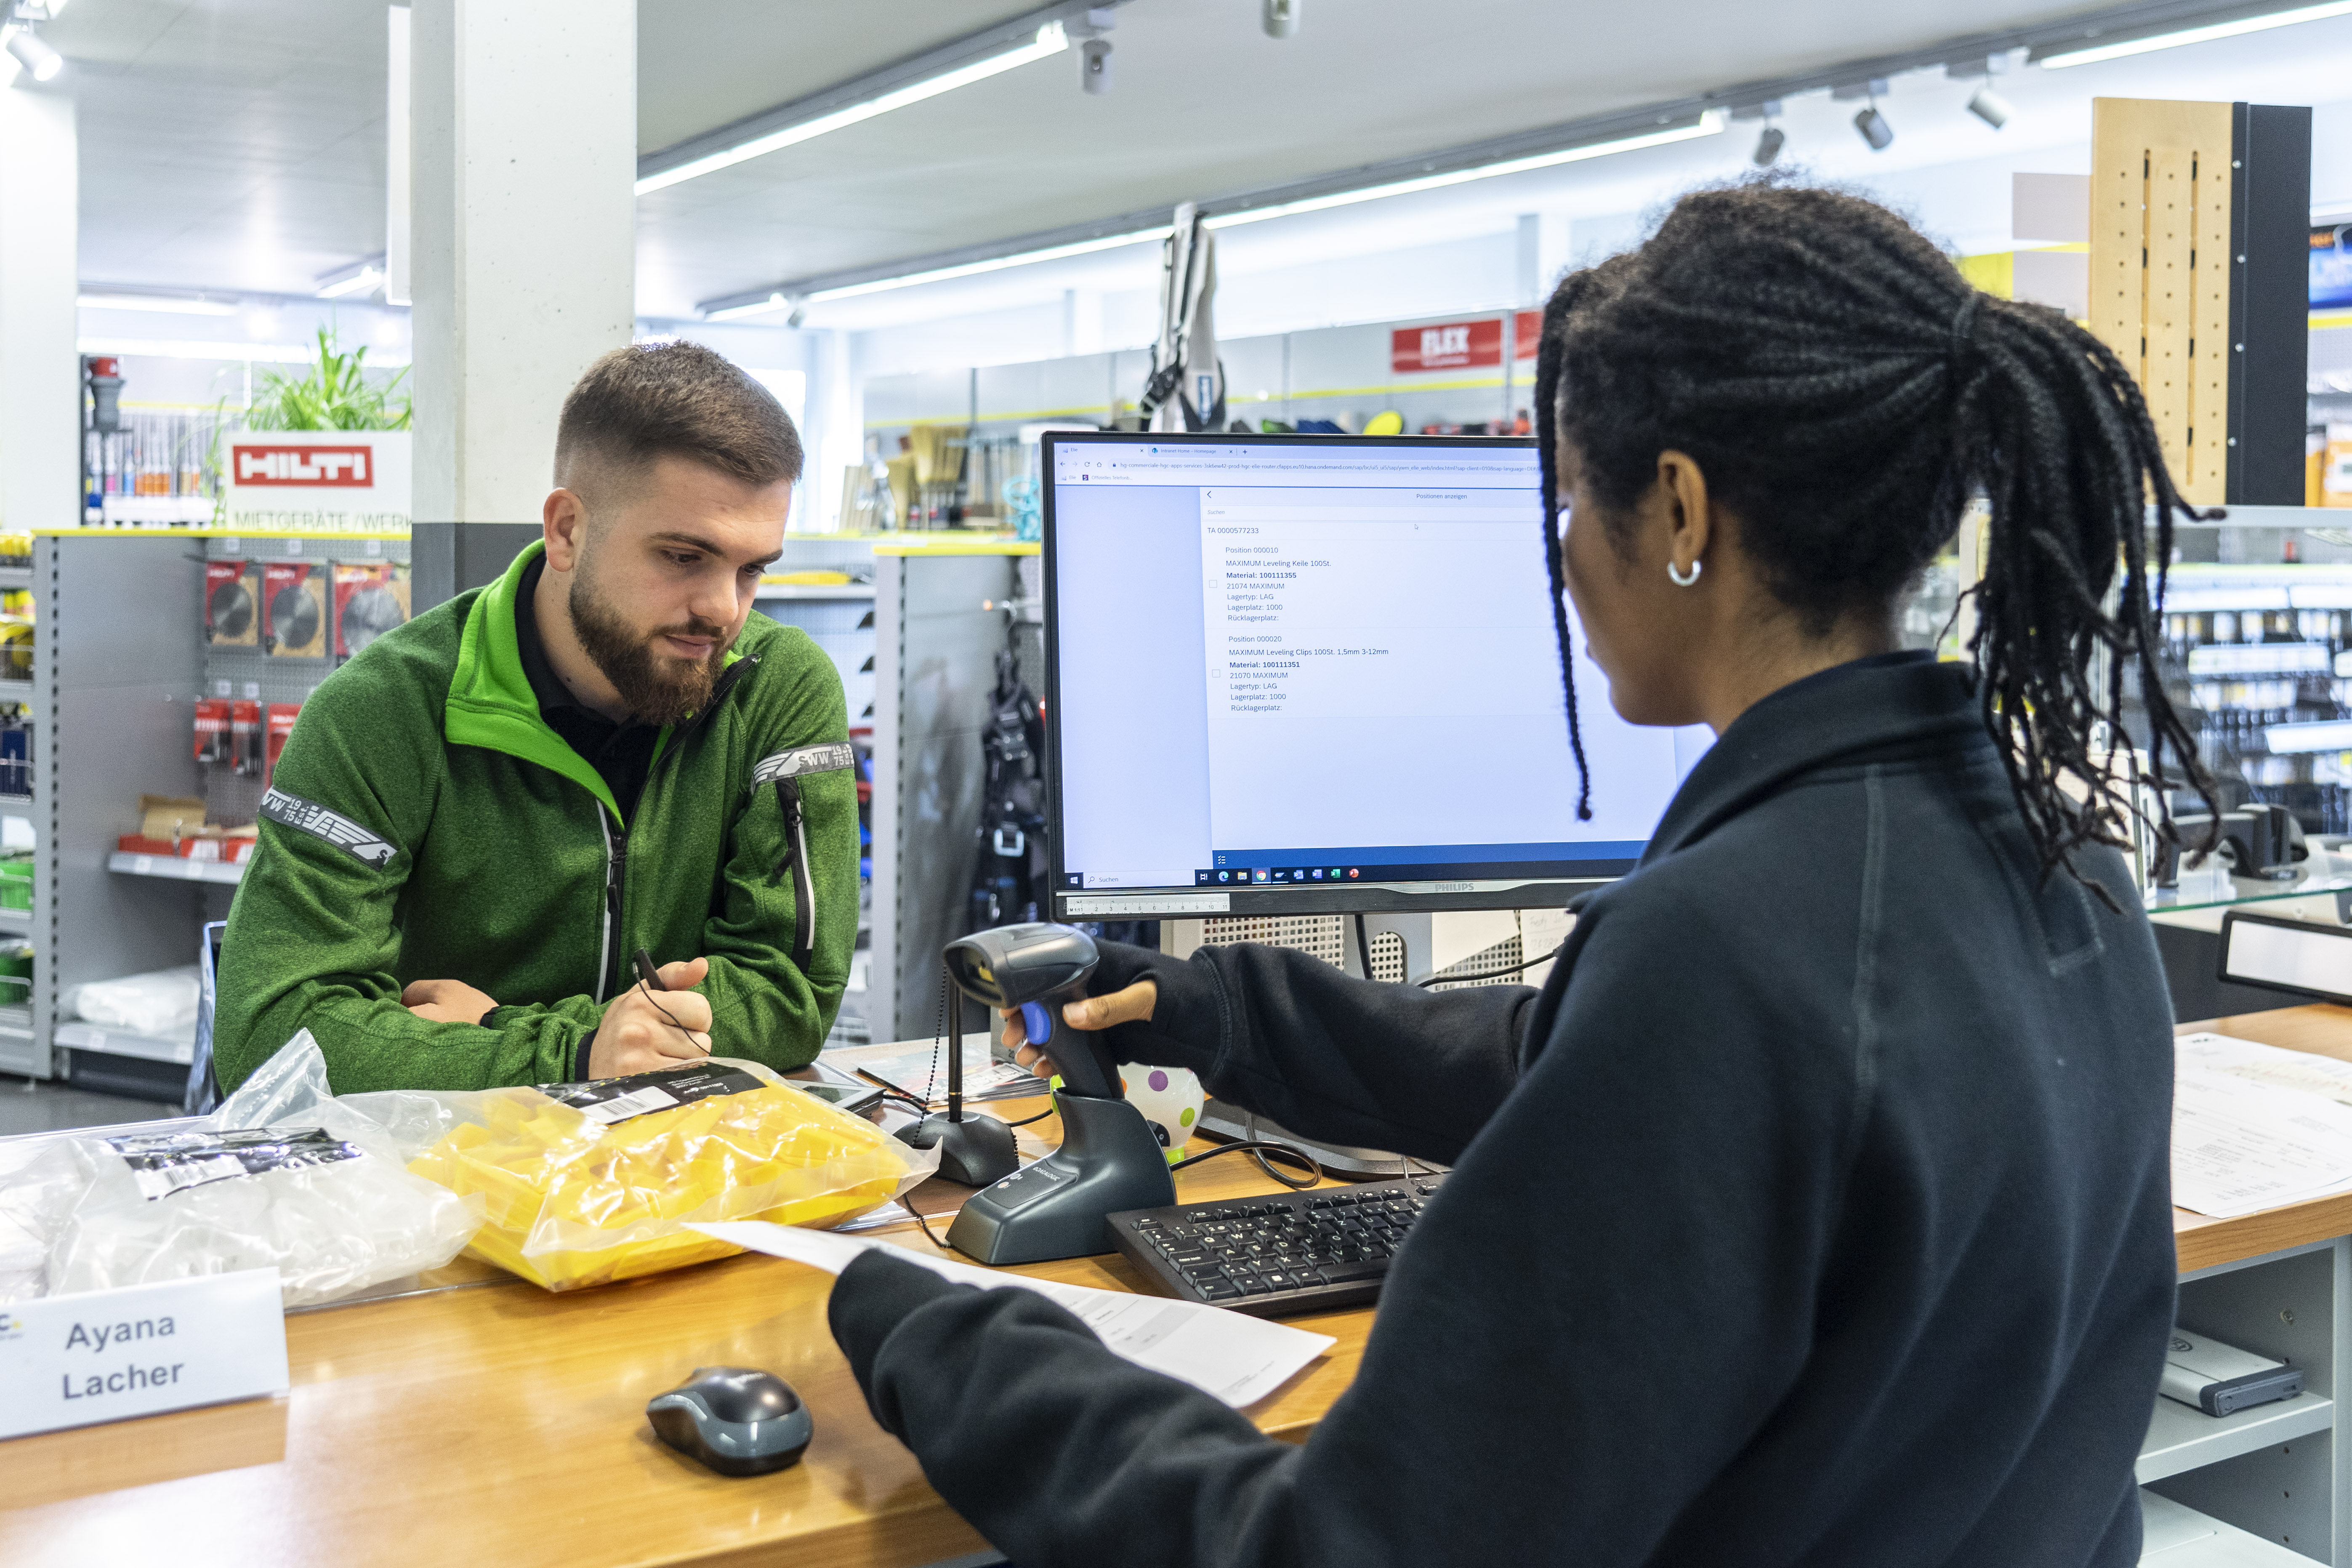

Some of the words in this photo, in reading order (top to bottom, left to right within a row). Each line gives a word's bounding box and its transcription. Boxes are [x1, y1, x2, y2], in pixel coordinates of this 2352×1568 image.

[240, 452, 366, 480] HILTI
[1266, 649, 1294, 657] Leveling
[1231, 704, 1282, 713] Rücklagerplatz:
[832, 745, 842, 756] 19
[834, 756, 844, 767] 75
[283, 809, 296, 822] 75
[1435, 883, 1474, 892] PHILIPS
[65, 1316, 176, 1353] Ayana
[62, 1363, 185, 1400] Lacher
